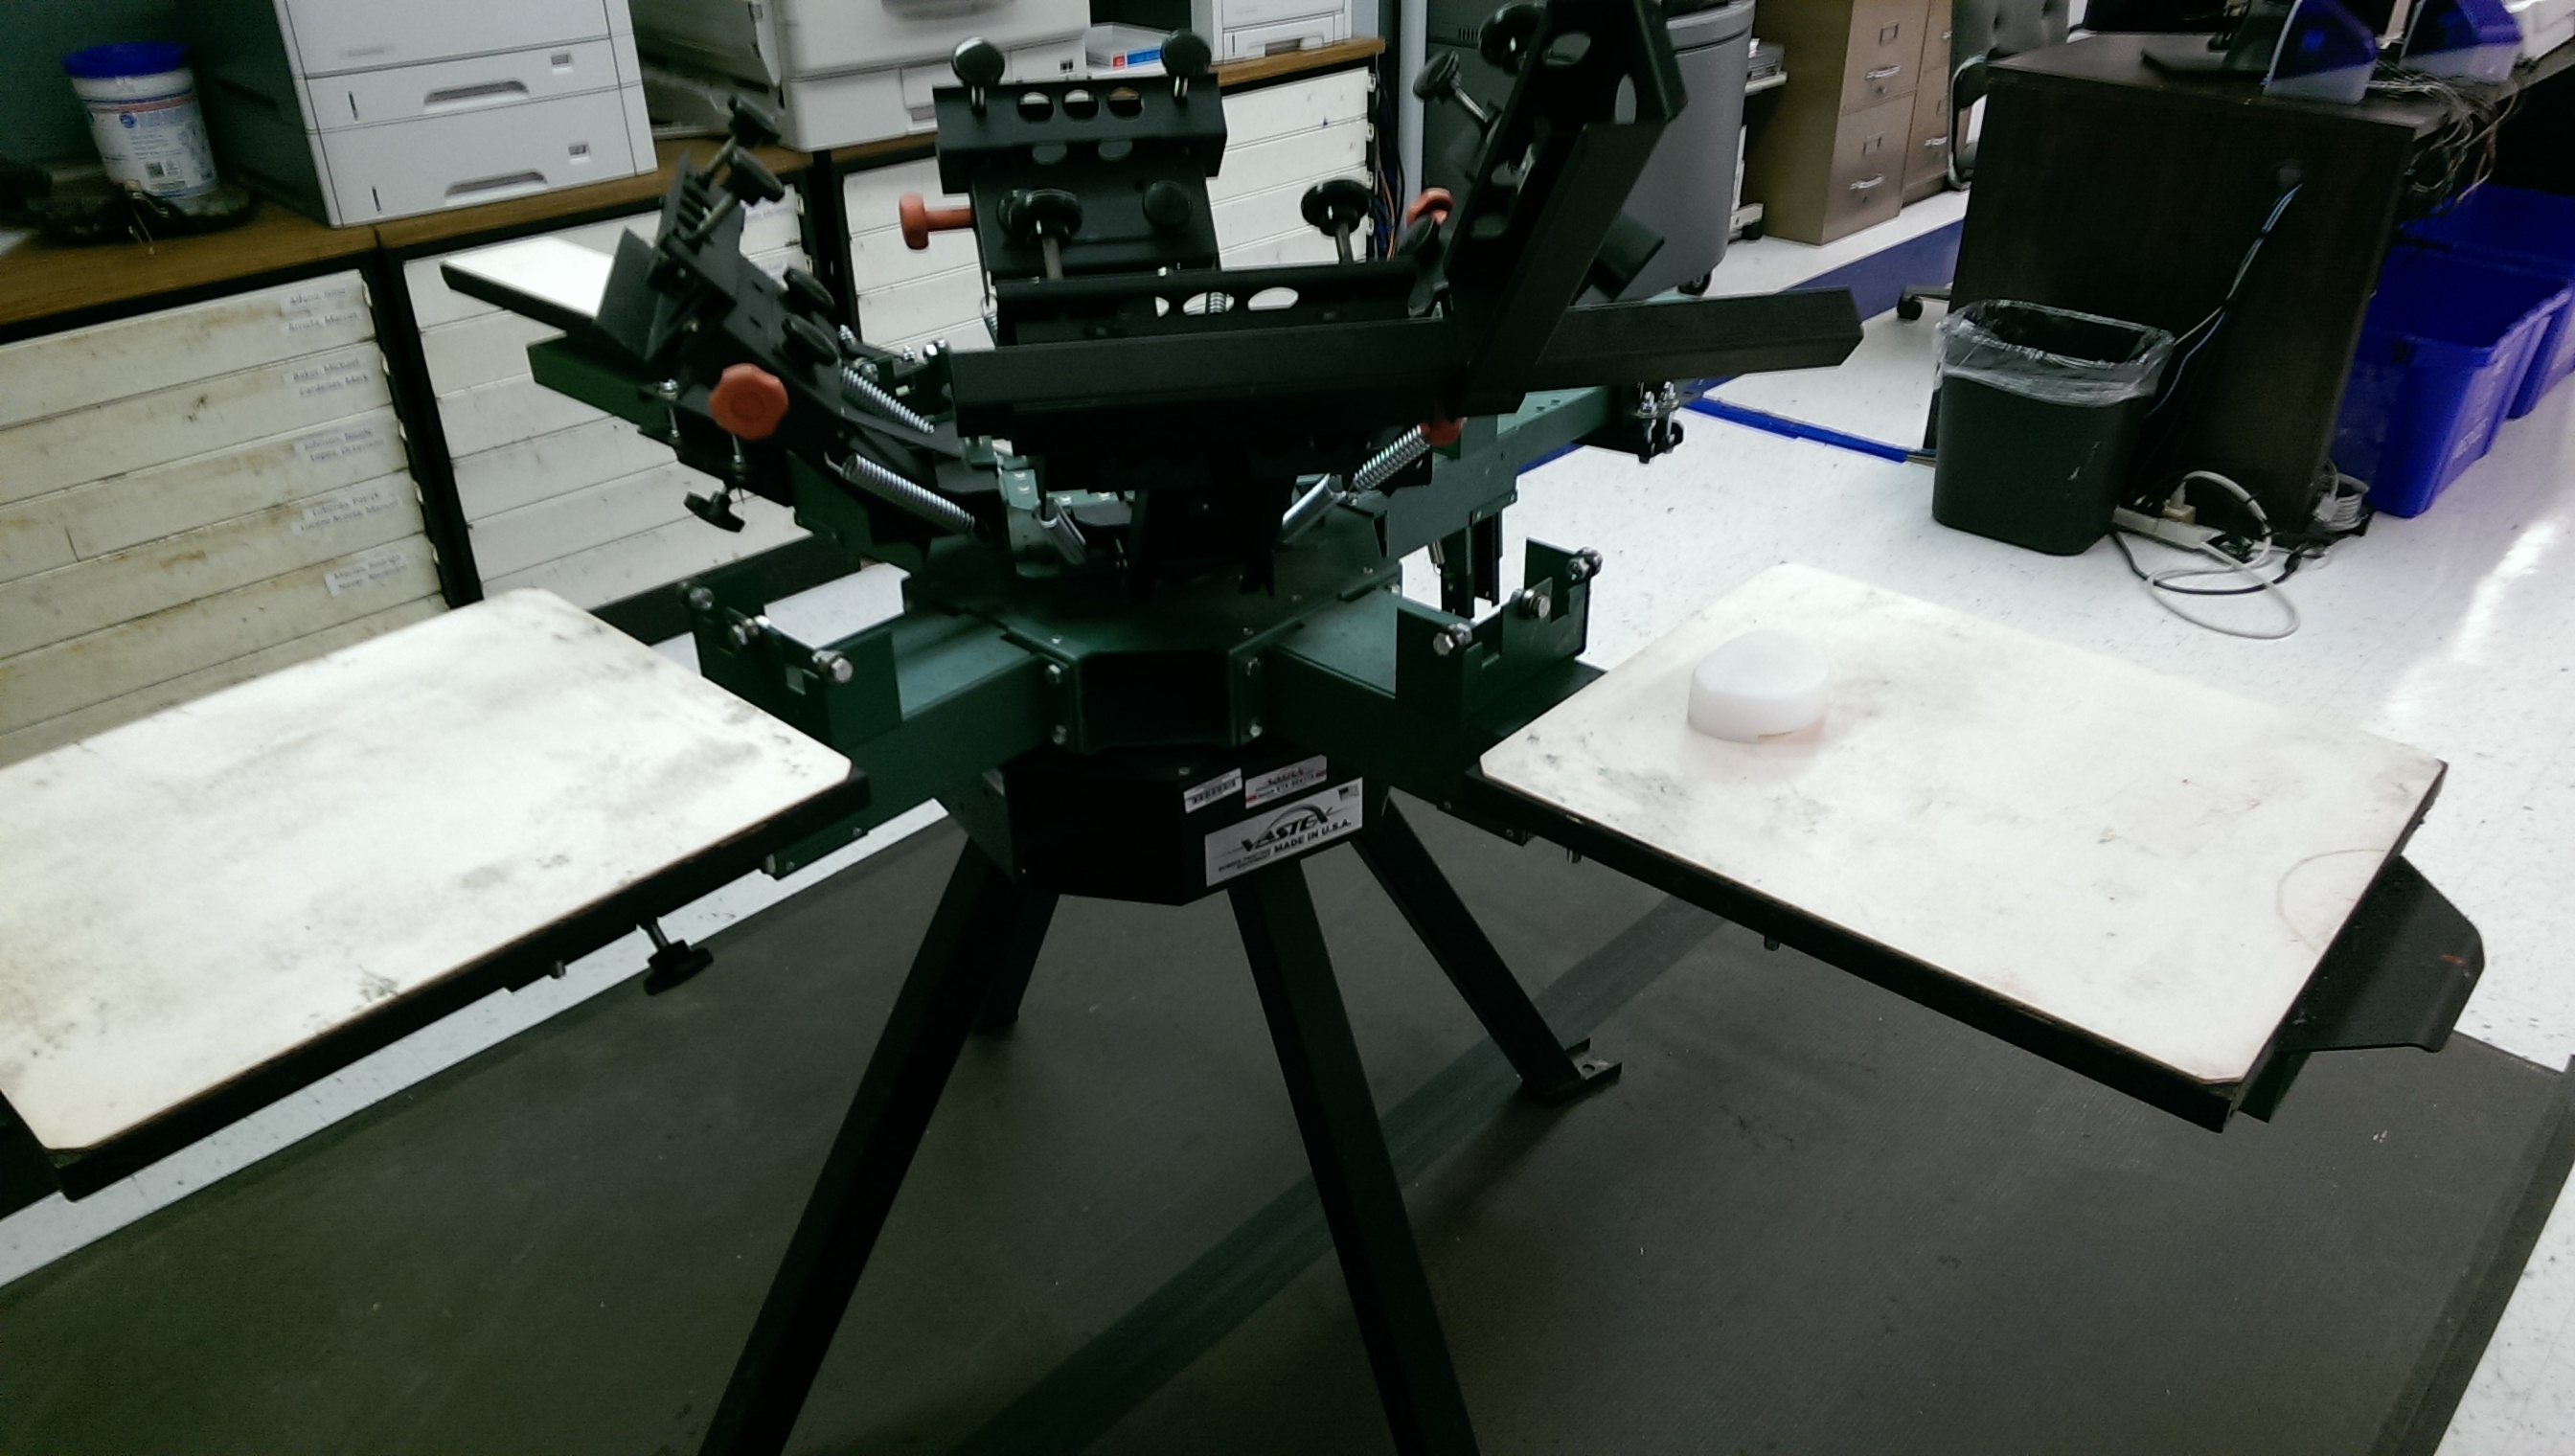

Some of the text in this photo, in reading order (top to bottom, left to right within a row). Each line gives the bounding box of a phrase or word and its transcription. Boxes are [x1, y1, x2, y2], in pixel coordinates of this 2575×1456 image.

[1241, 804, 1333, 852] VASTEX
[1274, 818, 1352, 853] MADE IN U.S.A.
